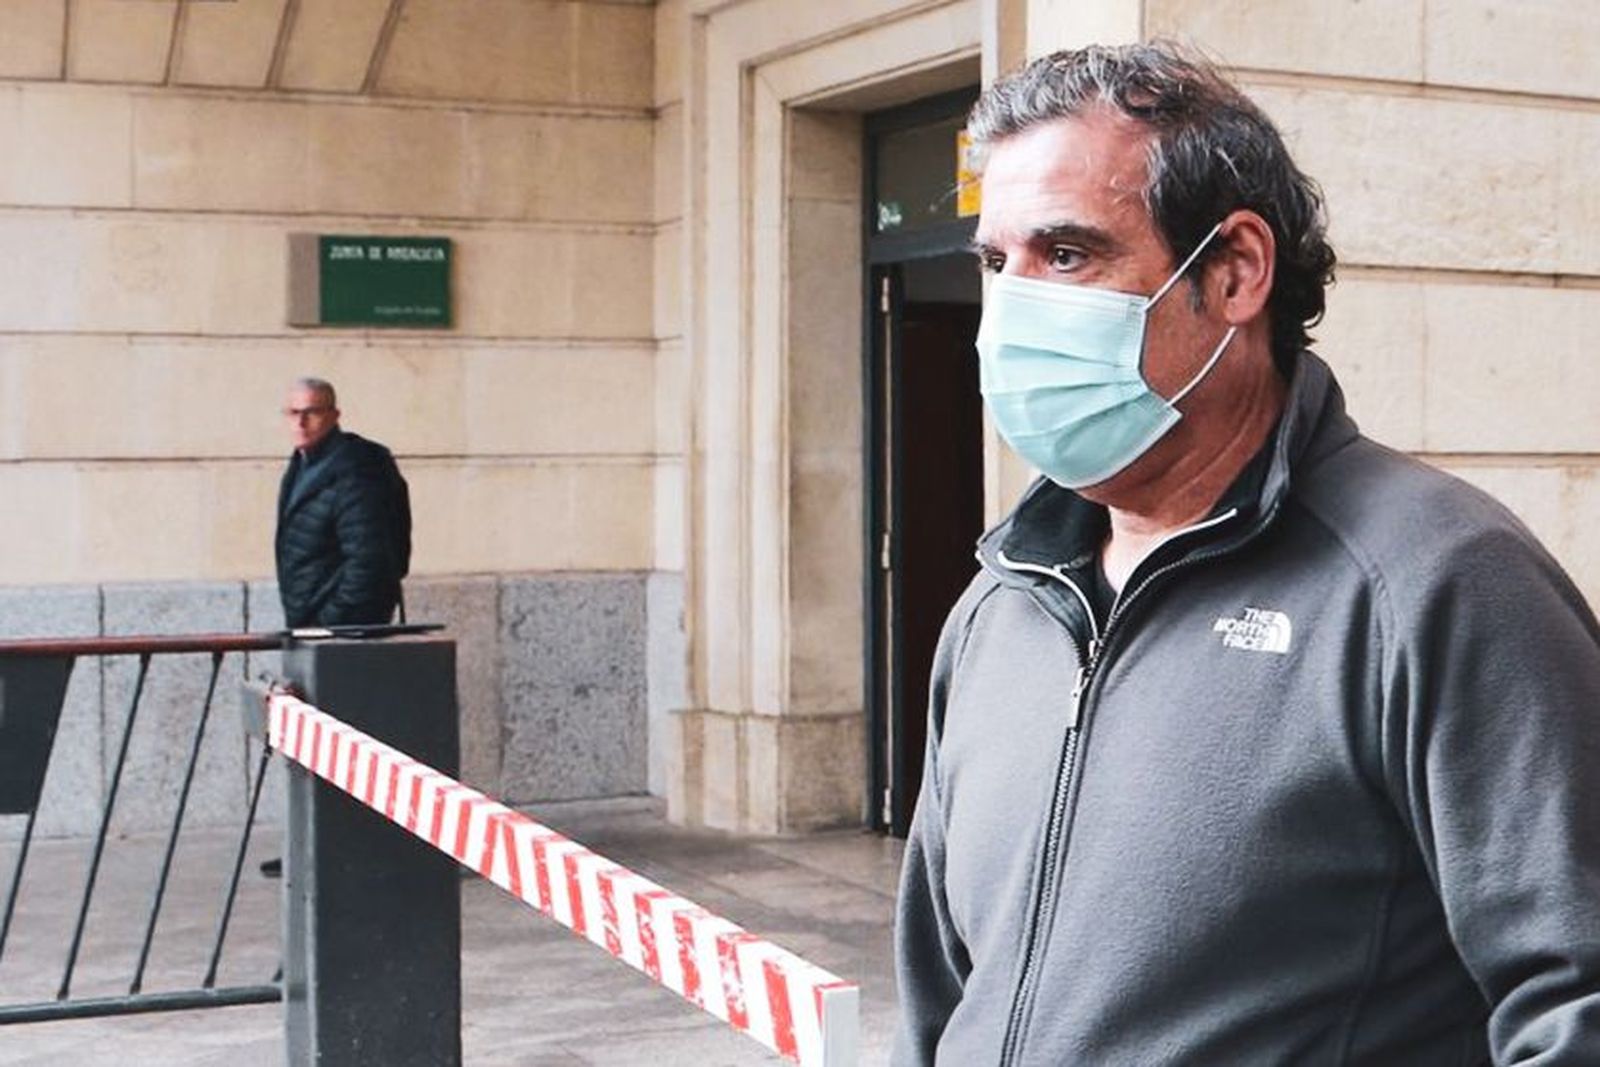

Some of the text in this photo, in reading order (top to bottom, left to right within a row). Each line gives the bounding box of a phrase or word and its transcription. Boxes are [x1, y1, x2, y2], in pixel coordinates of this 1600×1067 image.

[330, 246, 364, 260] JUNTA
[369, 246, 381, 260] DE
[1244, 607, 1274, 624] THE
[1213, 617, 1269, 639] NORTH
[1223, 634, 1267, 652] FACE
